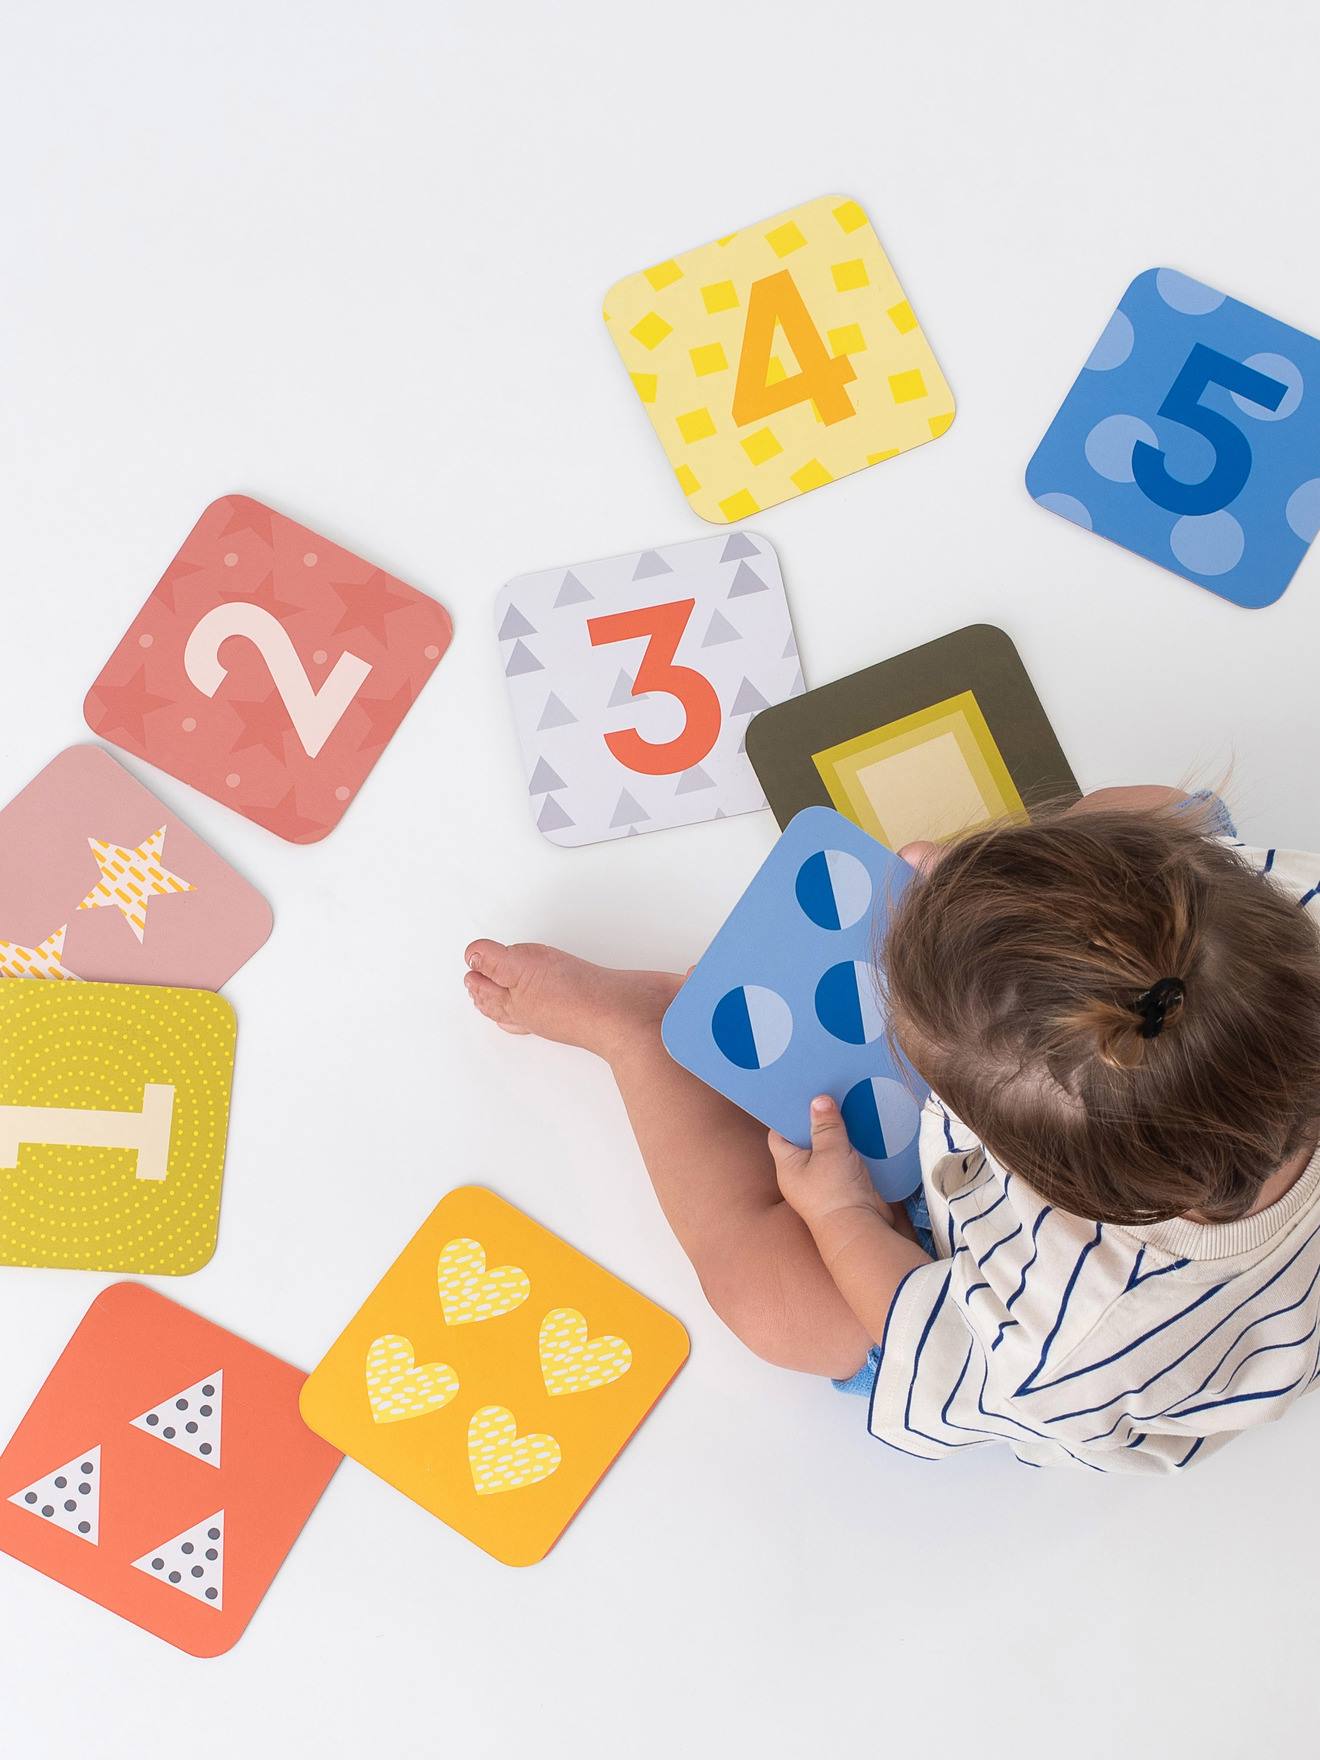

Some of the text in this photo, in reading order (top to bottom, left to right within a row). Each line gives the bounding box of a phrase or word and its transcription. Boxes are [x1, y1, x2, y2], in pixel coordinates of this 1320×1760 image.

[732, 269, 857, 427] 4
[1131, 342, 1289, 517] 5
[184, 601, 373, 759] 2
[586, 598, 722, 776] 3
[0, 1083, 176, 1182] 1
